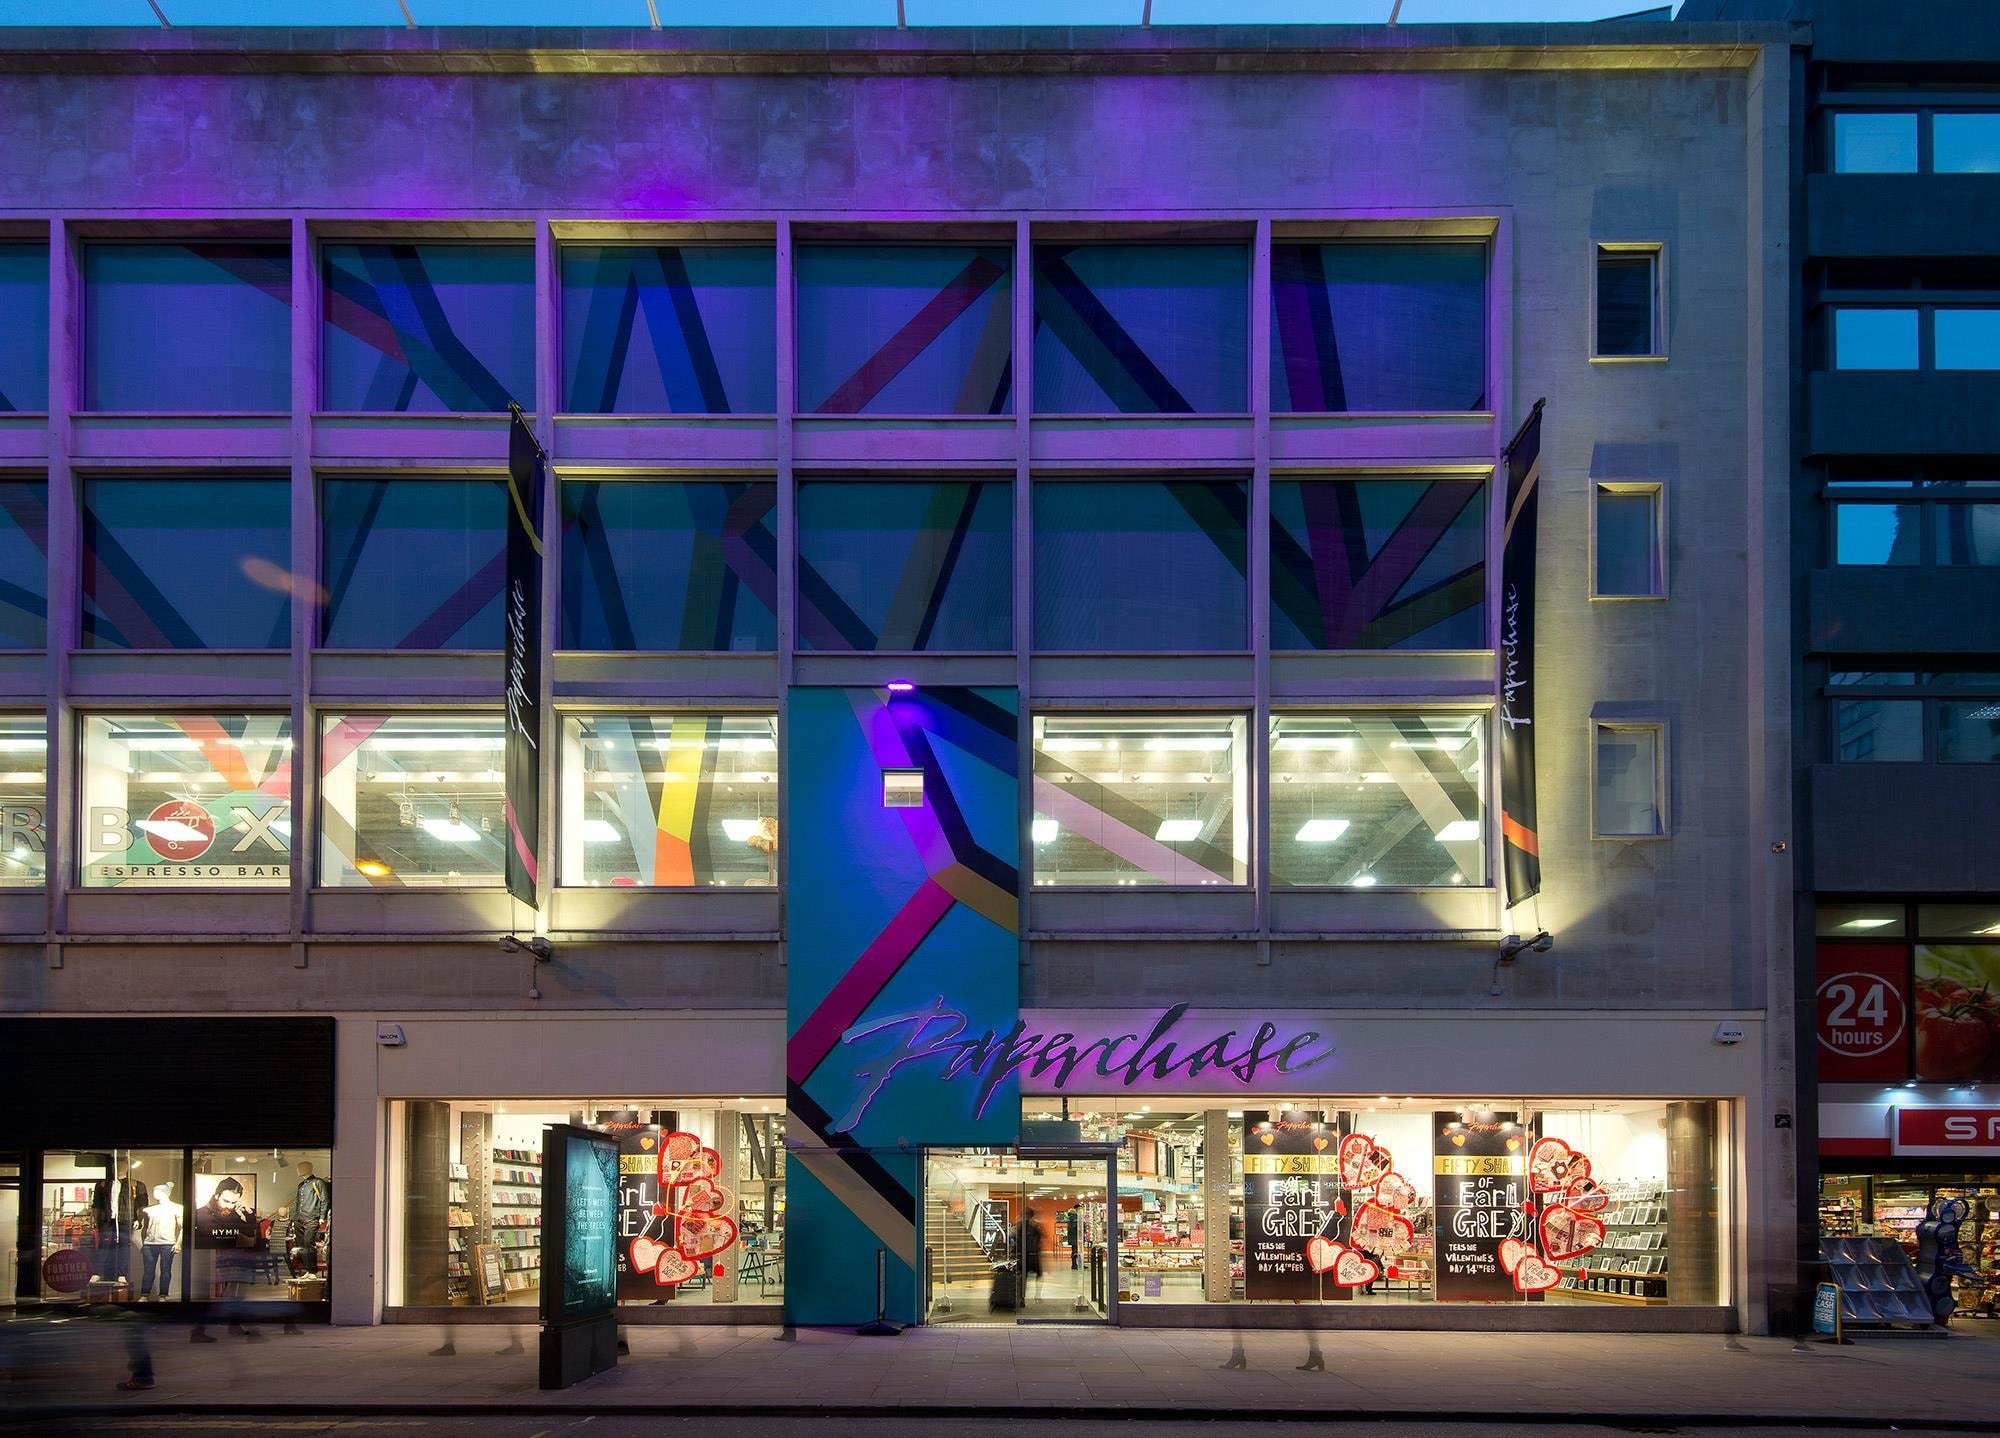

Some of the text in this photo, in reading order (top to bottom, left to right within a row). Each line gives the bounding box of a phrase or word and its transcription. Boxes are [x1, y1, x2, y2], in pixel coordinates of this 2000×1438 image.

[103, 866, 282, 876] ESPRESSO BAR
[1826, 984, 1889, 1026] 24
[1832, 1028, 1884, 1045] hours
[834, 994, 1336, 1133] Paperchase
[1251, 1157, 1288, 1173] FIFTY
[1442, 1158, 1480, 1174] FIFTY
[1478, 1177, 1493, 1188] OF
[1262, 1207, 1335, 1238] GREY
[1453, 1209, 1525, 1239] GREY
[47, 1262, 88, 1274] FURTHER
[1258, 1263, 1272, 1272] DAY
[1292, 1263, 1304, 1272] FEB
[1449, 1264, 1464, 1273] DAY
[1483, 1265, 1496, 1273] FEB
[1817, 1290, 1836, 1302] FREE
[1815, 1299, 1834, 1310] CASH
[1814, 1311, 1835, 1323] HERE
